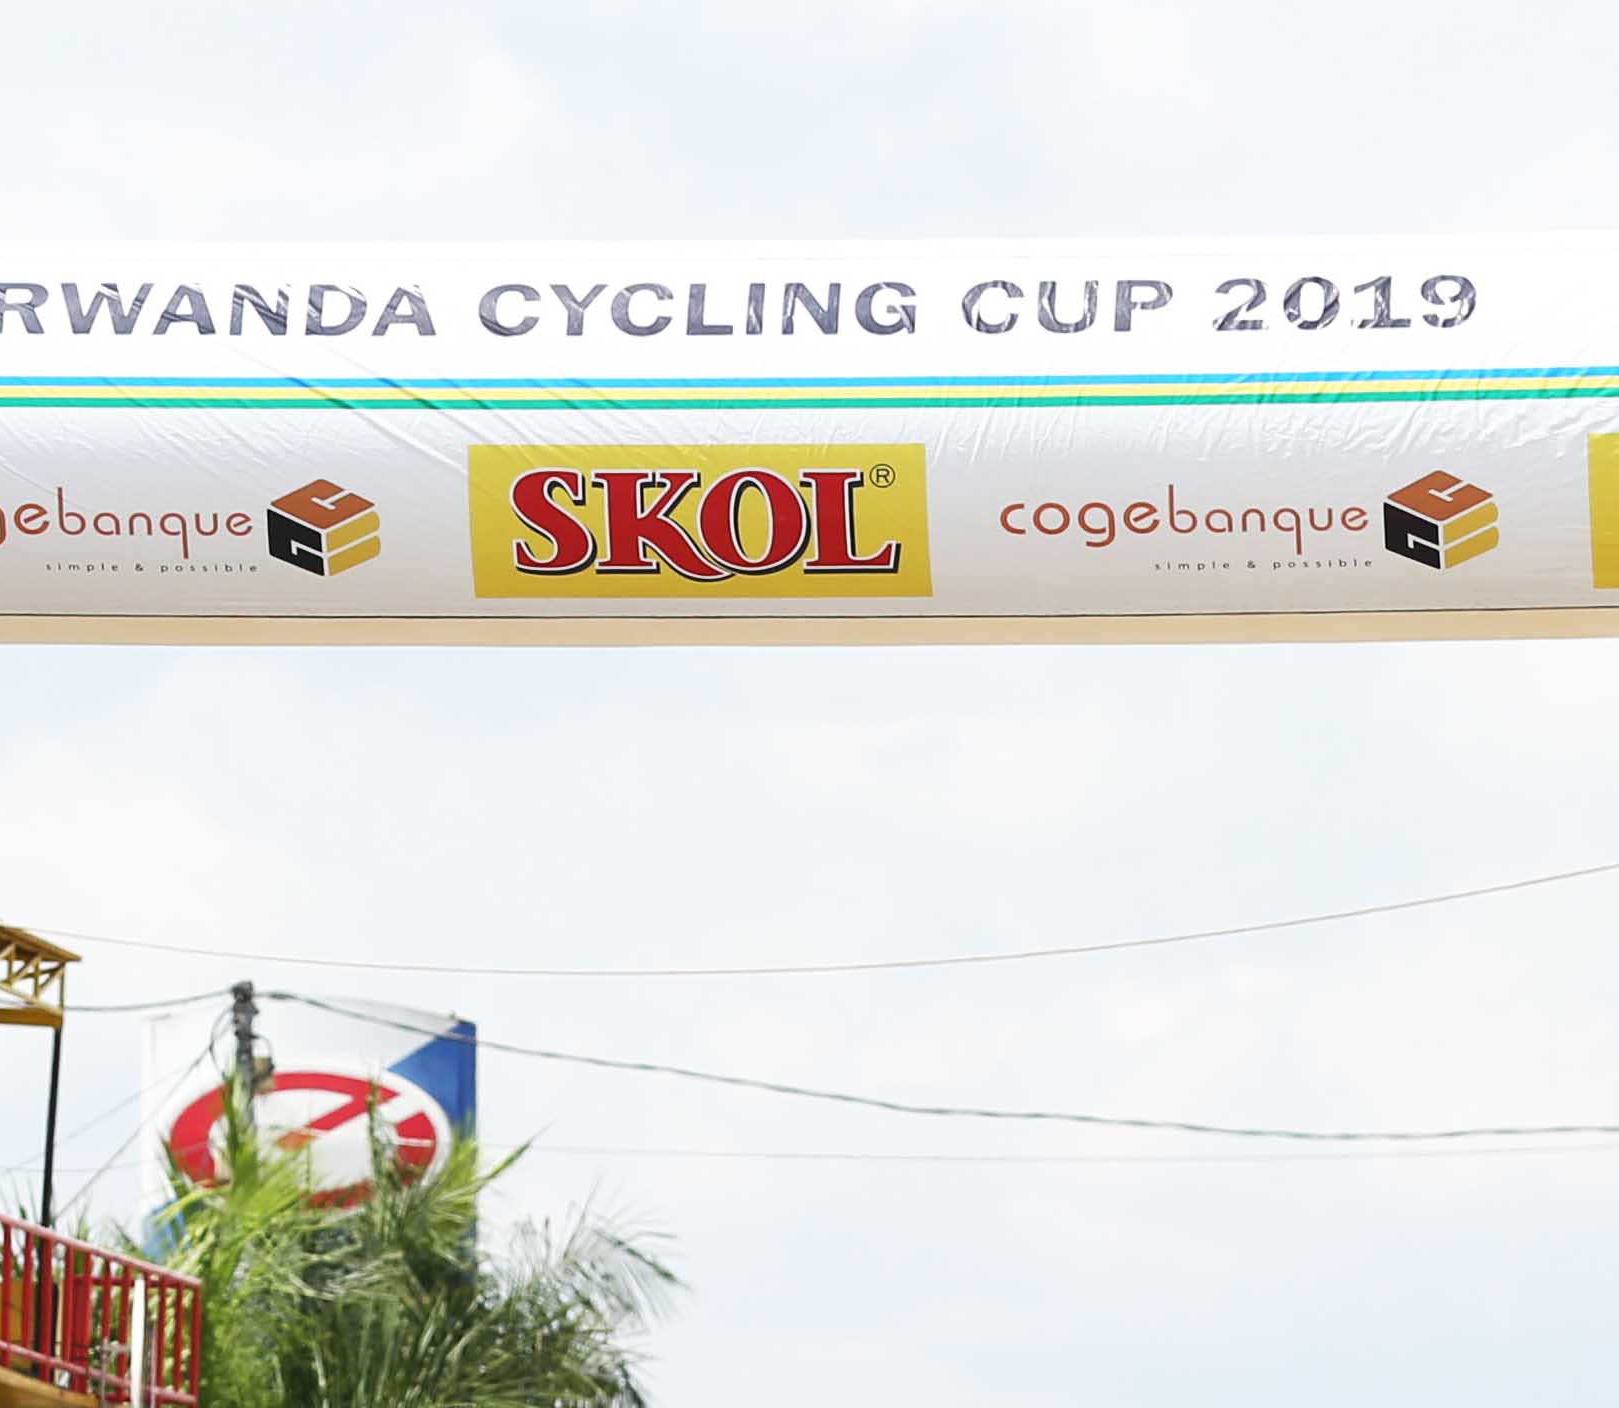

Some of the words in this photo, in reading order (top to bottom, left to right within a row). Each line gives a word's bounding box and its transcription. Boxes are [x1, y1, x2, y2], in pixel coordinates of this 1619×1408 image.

[478, 281, 918, 338] CYCLING
[961, 277, 1175, 335] CUP
[1213, 274, 1478, 332] 2019
[999, 484, 1369, 556] cogebanque
[46, 561, 120, 575] simple
[134, 561, 145, 572] &
[159, 560, 259, 574] possible
[1154, 560, 1231, 573] simple
[1247, 560, 1256, 570] &
[1273, 558, 1373, 571] possible
